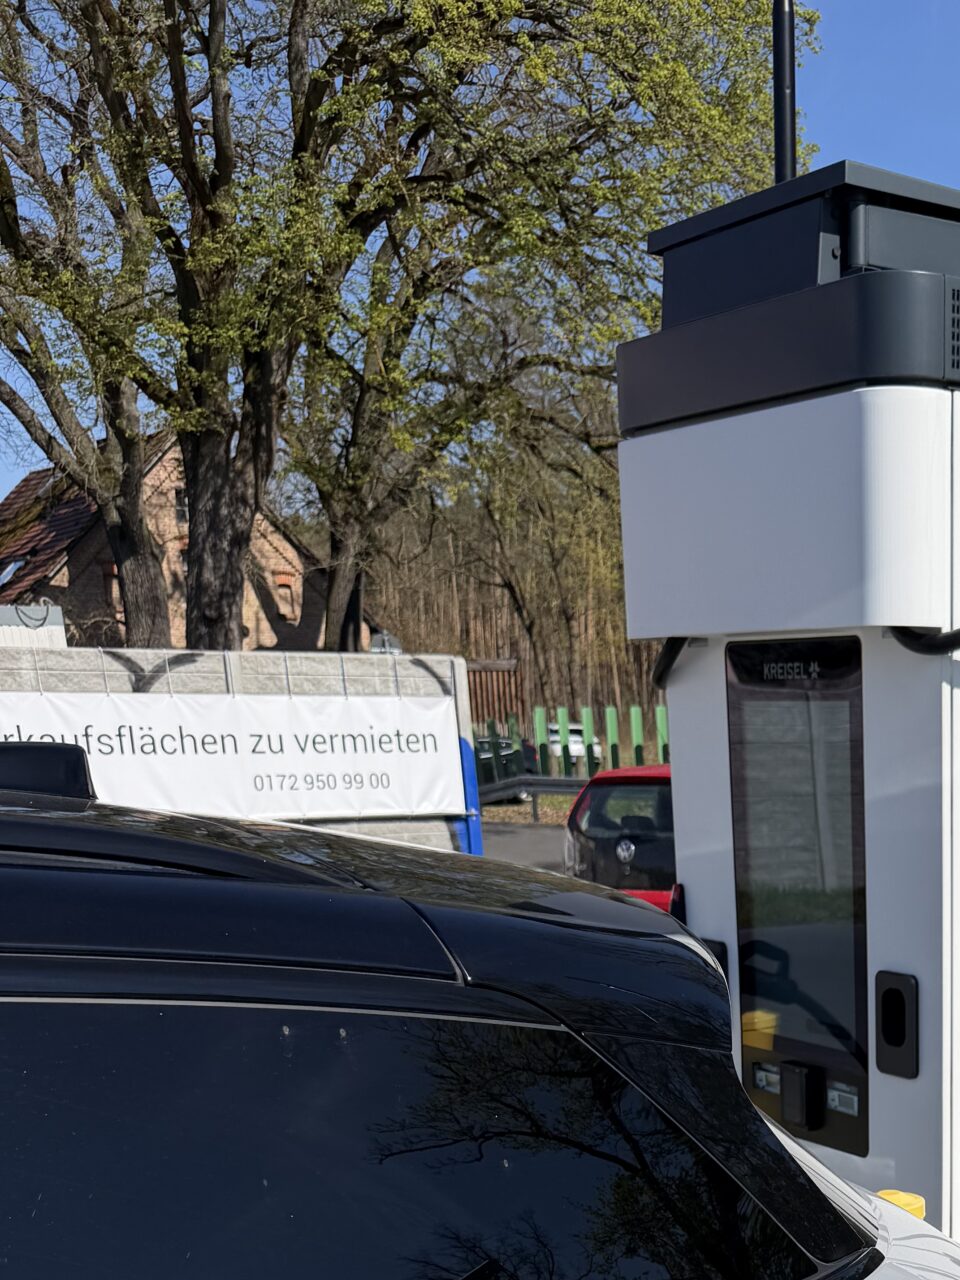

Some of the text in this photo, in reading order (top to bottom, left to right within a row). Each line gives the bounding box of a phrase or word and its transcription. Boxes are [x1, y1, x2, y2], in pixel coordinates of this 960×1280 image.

[763, 661, 807, 680] KREISEL
[249, 733, 285, 754] zu
[293, 725, 438, 754] vermieten
[253, 772, 391, 792] 0172 950 99 00
